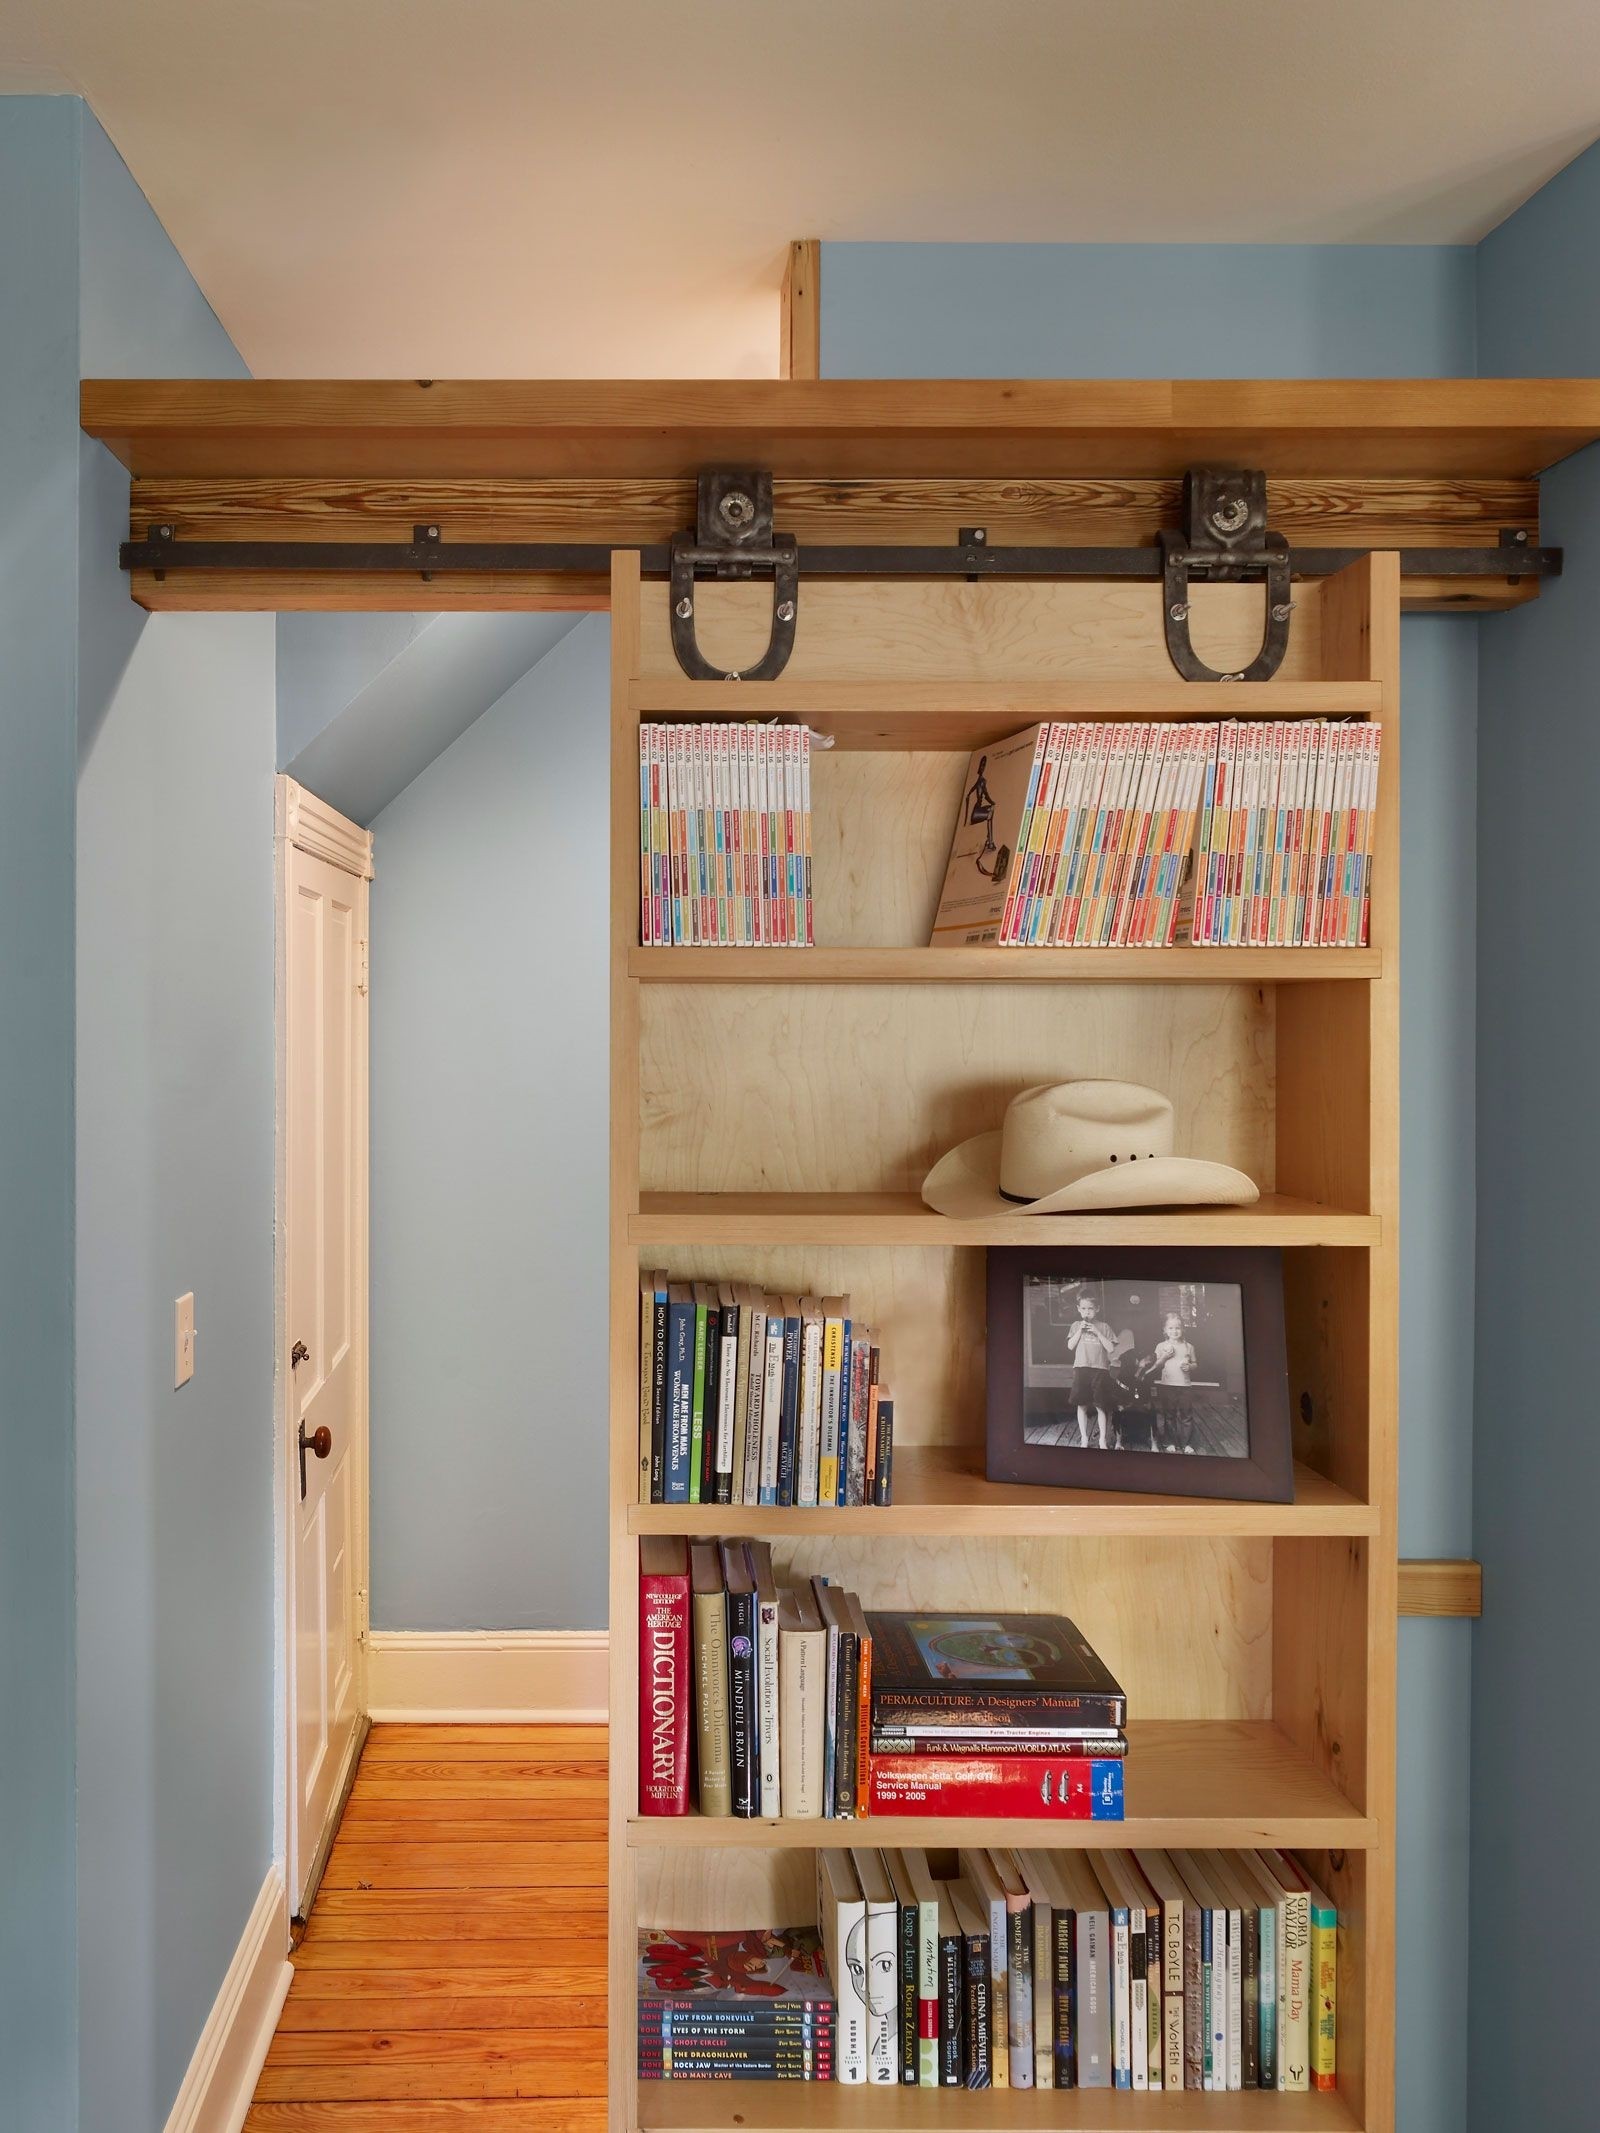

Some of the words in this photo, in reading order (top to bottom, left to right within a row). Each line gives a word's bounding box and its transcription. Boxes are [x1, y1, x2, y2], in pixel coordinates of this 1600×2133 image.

[660, 754, 664, 762] 04
[657, 1324, 664, 1334] TO
[785, 1332, 793, 1361] POWER
[681, 1384, 689, 1399] MEN
[753, 1373, 761, 1410] TOWARD
[672, 1417, 680, 1443] FROM
[680, 1415, 688, 1435] FROM
[694, 1411, 702, 1439] LESS
[752, 1411, 760, 1461] WHOLENESS
[671, 1444, 679, 1470] VENUS
[680, 1436, 688, 1456] MARS
[780, 1441, 788, 1479] BACEVICH
[710, 1611, 721, 1634] The
[765, 1637, 774, 1665] Social
[711, 1638, 723, 1705] Omnivore's
[799, 1665, 807, 1691] Language
[845, 1664, 852, 1672] of
[734, 1669, 744, 1726] MINDFUL
[764, 1666, 774, 1708] Evolution
[653, 1631, 675, 1784] DICTIONARY
[880, 1695, 974, 1705] PERMACULTURE:
[977, 1697, 985, 1705] A
[988, 1696, 1038, 1709] Designers'
[1042, 1697, 1080, 1708] Manual
[765, 1715, 775, 1744] Trivers
[860, 1704, 868, 1733] Difficult
[713, 1709, 725, 1763] Dilemma
[735, 1731, 745, 1768] BRAIN
[926, 1744, 941, 1752] Funk
[942, 1744, 948, 1752] &
[950, 1744, 980, 1754] Wagnalls
[981, 1744, 1017, 1752] Hammond
[1017, 1744, 1047, 1752] WORLD
[859, 1737, 868, 1785] Conversations
[646, 1785, 683, 1793] HOUGHTON
[876, 1771, 927, 1781] Volkswagen
[876, 1781, 908, 1789] Service
[911, 1781, 942, 1789] Manual
[905, 1792, 926, 1800] 2005
[905, 1911, 915, 1937] LORD
[1168, 1914, 1180, 1937] T.C.
[1285, 1896, 1297, 1950] NAYLOR
[1297, 1897, 1308, 1947] GLORIA
[1058, 1920, 1068, 1953] MARGARET
[905, 1950, 915, 1980] LIGHT
[924, 1939, 935, 1987] intuition
[1059, 1955, 1069, 1982] ATWOOD
[1291, 1959, 1303, 1996] Mama
[905, 1984, 914, 2019] ROGER
[977, 1983, 986, 2020] CHINA
[1059, 1995, 1068, 2013] ORYX
[1287, 2000, 1303, 2022] Day
[1060, 2015, 1068, 2025] AND
[905, 2022, 914, 2065] ZELAZNY
[978, 2022, 988, 2072] MIÉVILLE
[1059, 2026, 1069, 2047] CRAKE
[849, 2068, 857, 2080] 1
[878, 2068, 890, 2081] 2
